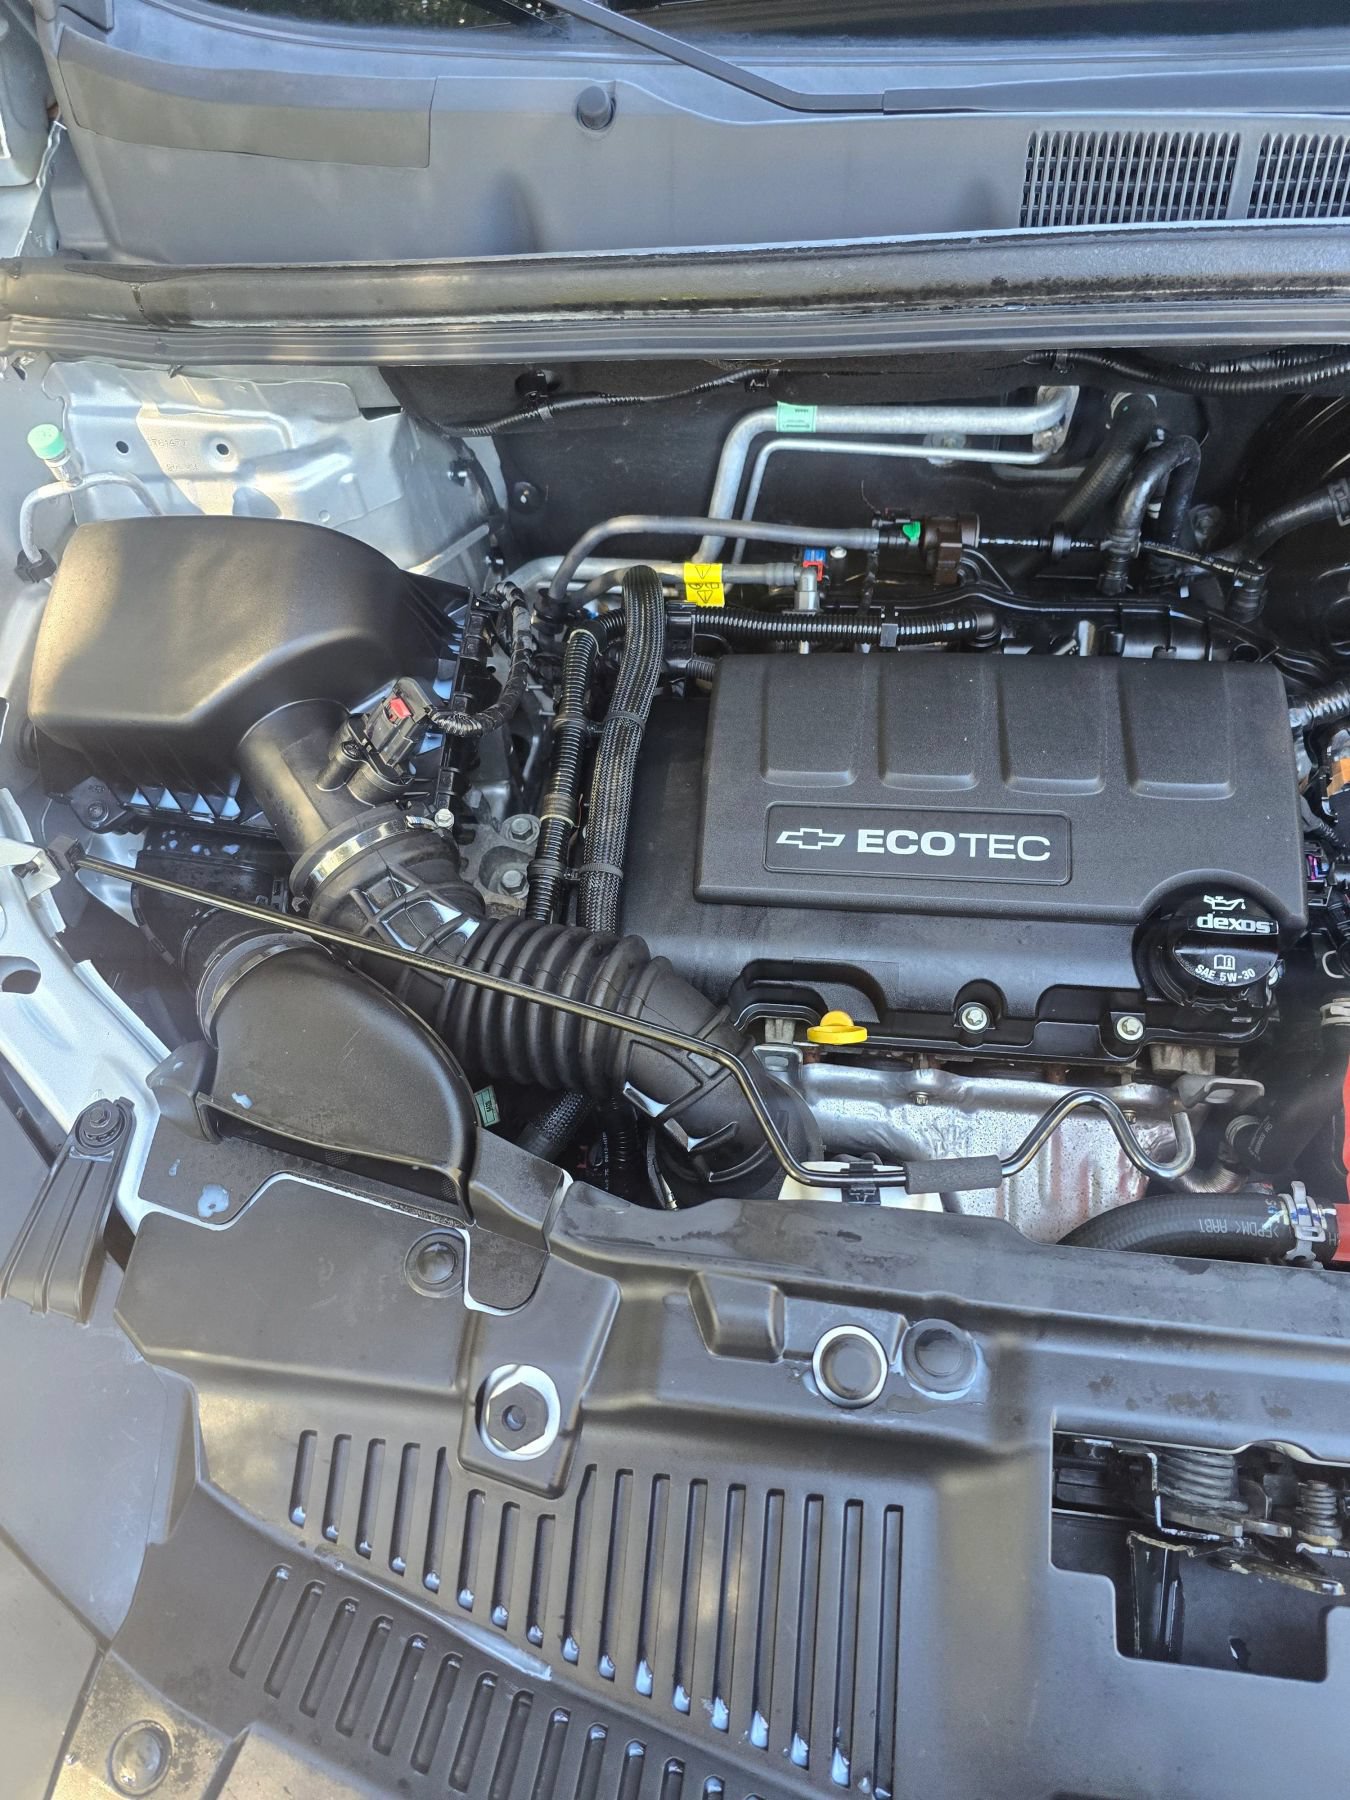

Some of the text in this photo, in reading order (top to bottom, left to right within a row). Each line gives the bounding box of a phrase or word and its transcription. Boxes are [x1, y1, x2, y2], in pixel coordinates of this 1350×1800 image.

[856, 829, 1051, 862] ECOTEC
[1196, 913, 1272, 934] dexos
[1195, 964, 1216, 980] SAE
[1219, 968, 1256, 983] 5W-30
